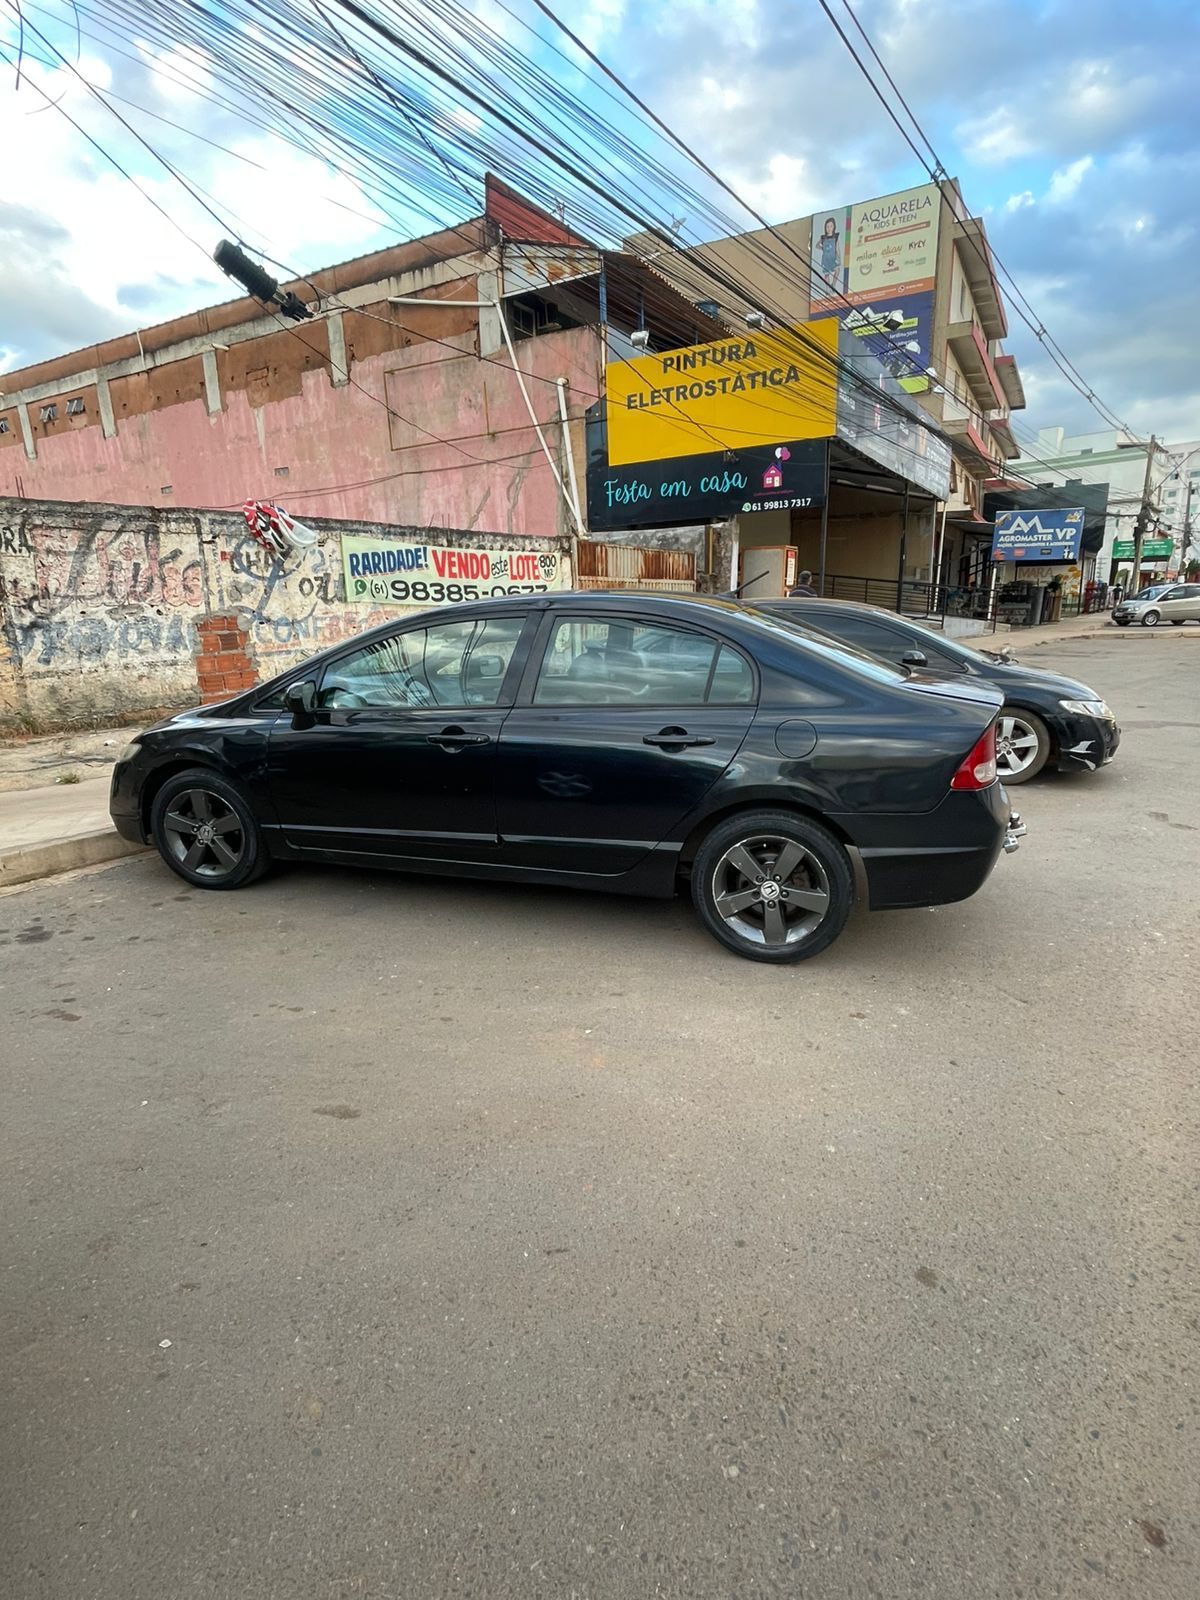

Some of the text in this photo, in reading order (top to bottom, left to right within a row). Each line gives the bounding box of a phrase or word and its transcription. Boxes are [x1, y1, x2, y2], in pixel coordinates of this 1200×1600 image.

[860, 196, 931, 224] AQUARELA
[873, 213, 917, 230] KIDS E TEEN
[662, 341, 757, 373] PINTURA
[626, 365, 800, 410] ELETROSTÁTICA
[603, 471, 748, 507] Festa em casa
[752, 498, 812, 511] 61 99813 7317
[998, 534, 1053, 543] AGROMASTER
[1055, 527, 1077, 540] VP
[349, 546, 540, 580] RARIDADE! VENDO este LOTE
[539, 554, 556, 568] 800
[370, 579, 389, 599] (61)
